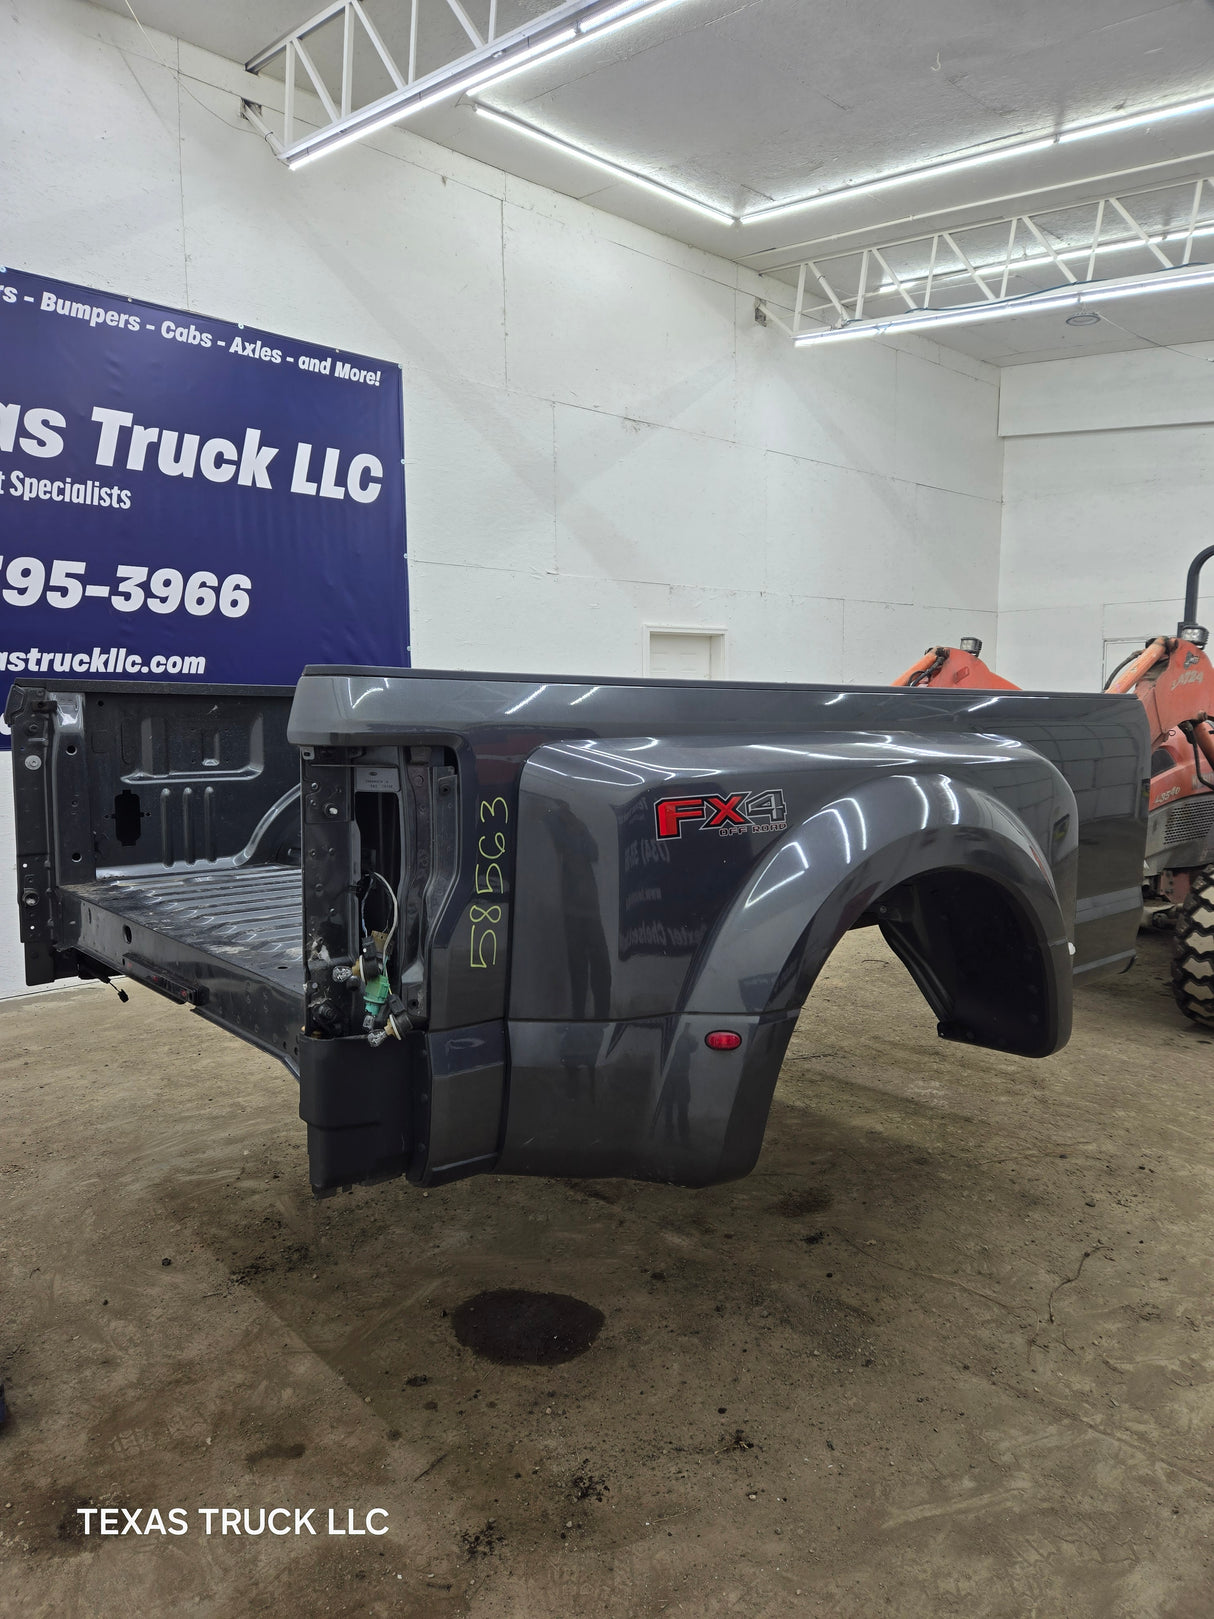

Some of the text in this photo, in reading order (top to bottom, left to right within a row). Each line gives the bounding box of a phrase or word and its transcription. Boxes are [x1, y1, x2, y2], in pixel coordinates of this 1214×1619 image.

[40, 291, 141, 332] Bumpers
[160, 320, 213, 348] Cabs
[229, 336, 282, 364] Axles
[298, 354, 331, 375] and
[334, 361, 381, 387] More!
[91, 406, 280, 490] Truck
[290, 442, 384, 504] LLC
[9, 470, 132, 510] Specialists
[0, 555, 252, 618] 95-3966
[654, 789, 787, 841] FX4
[719, 822, 787, 837] OFF ROAD
[470, 796, 508, 968] 58563
